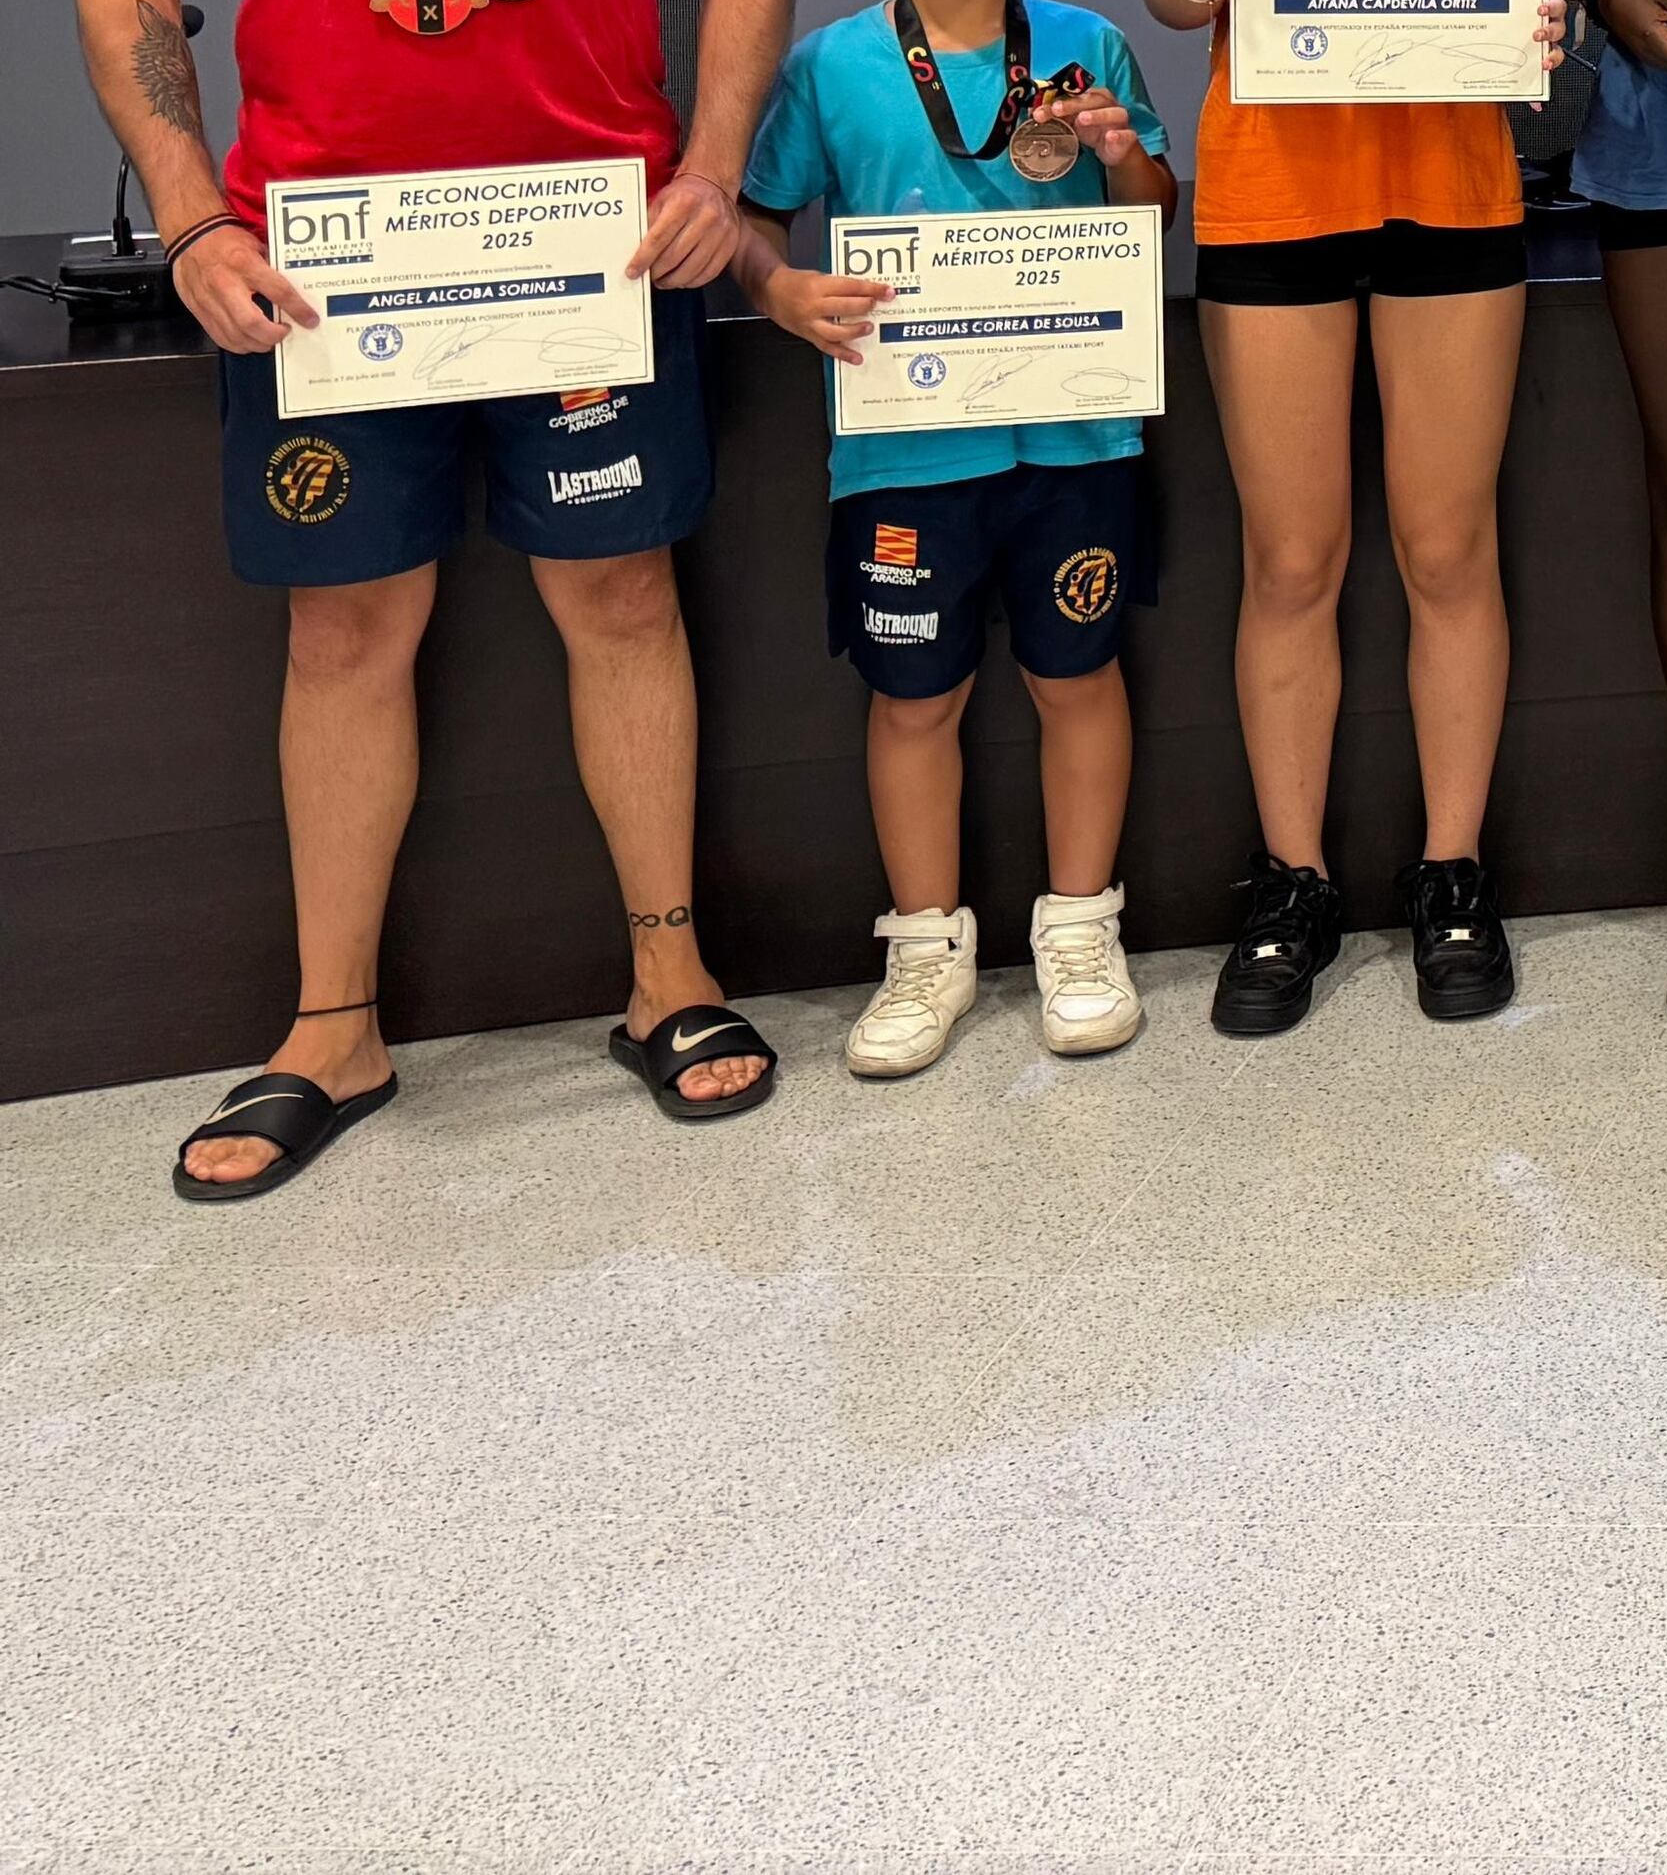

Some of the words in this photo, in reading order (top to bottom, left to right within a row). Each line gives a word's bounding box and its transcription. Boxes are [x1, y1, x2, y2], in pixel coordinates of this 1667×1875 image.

[398, 175, 609, 207] RECONOCIMIENTO
[281, 200, 372, 246] bnf
[384, 208, 480, 233] MÉRITOS
[487, 198, 623, 225] DEPORTIVOS
[481, 229, 534, 250] 2025
[943, 220, 1128, 244] RECONOCIMIENTO
[843, 236, 921, 276] bnf
[930, 246, 1015, 267] MÉRITOS
[1020, 242, 1141, 263] DEPORTIVOS
[1014, 268, 1061, 286] 2025
[367, 290, 423, 309] ANGEL
[425, 284, 494, 303] ALCOBA
[497, 278, 566, 297] SORINAS
[901, 321, 969, 337] EZEQUIAS
[971, 318, 1029, 333] CORREA
[1032, 316, 1052, 330] DE
[1053, 314, 1100, 329] SOUSA
[548, 402, 611, 429] GOBIERNO
[612, 395, 630, 410] DE
[547, 454, 643, 504] LASTROUND
[915, 568, 932, 580] DE
[861, 601, 940, 641] LASTROUND
